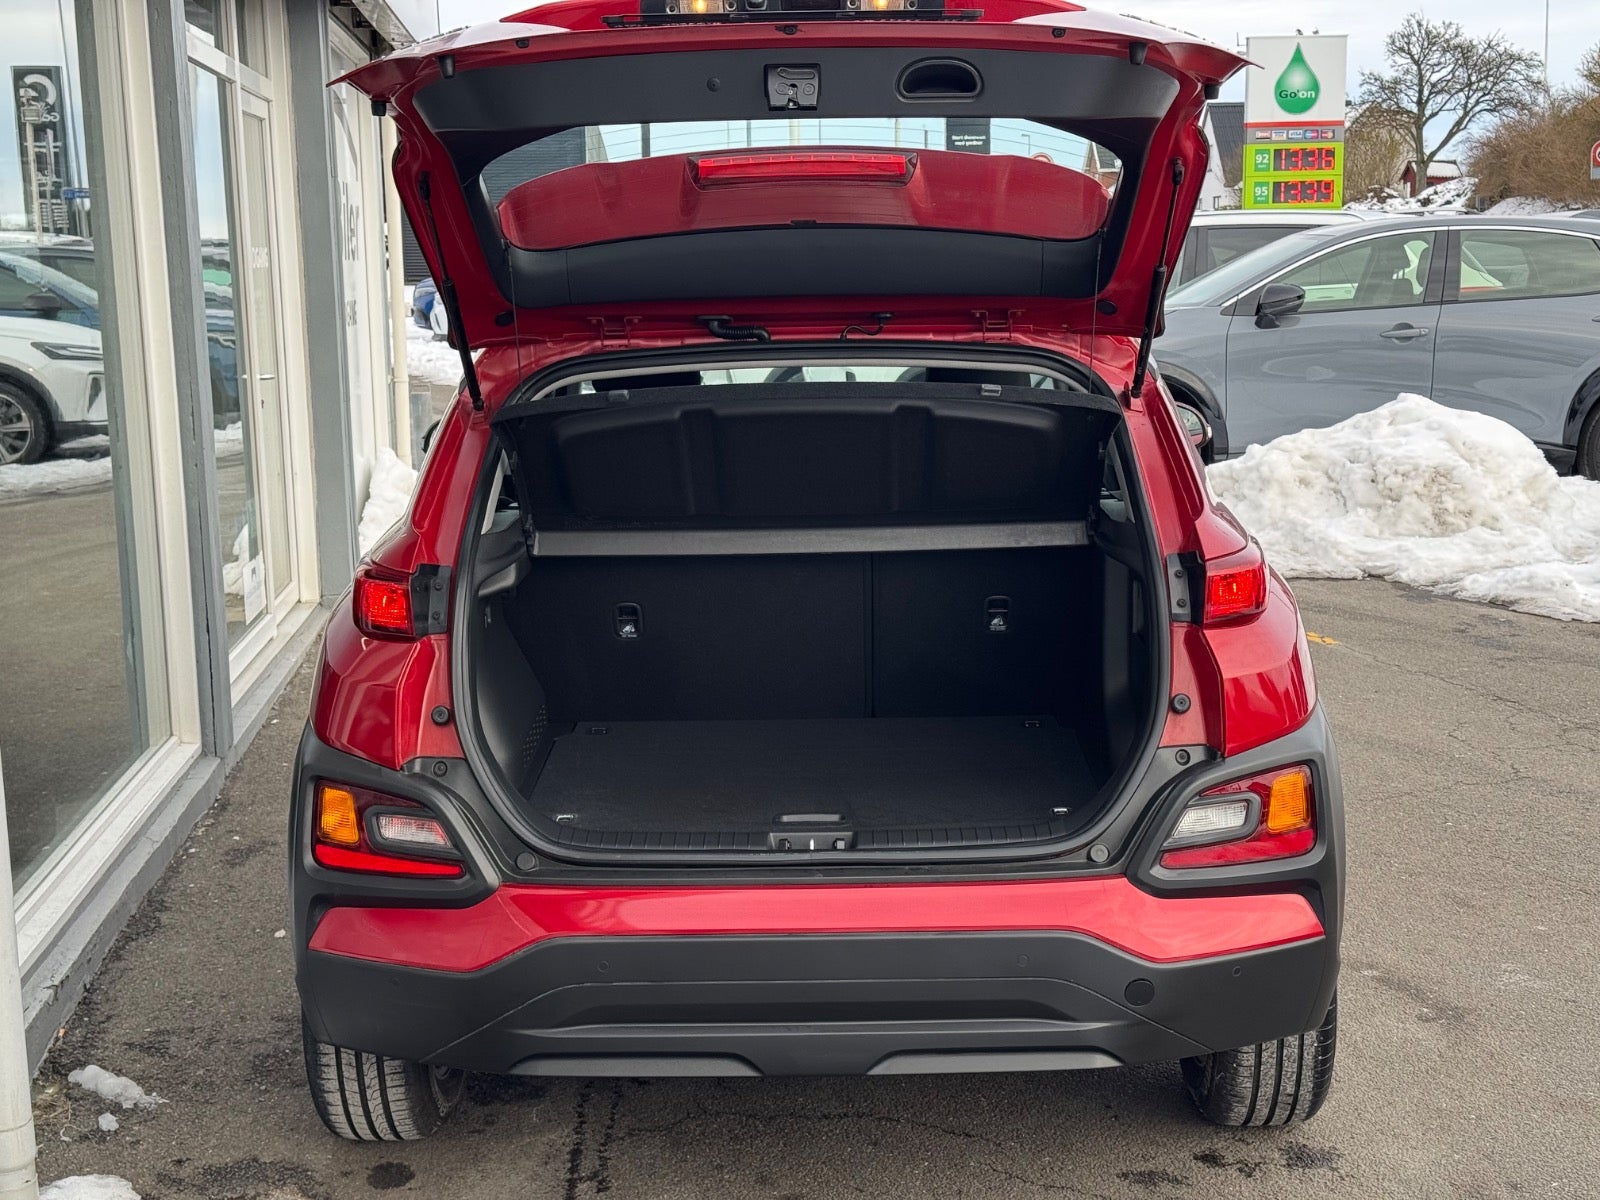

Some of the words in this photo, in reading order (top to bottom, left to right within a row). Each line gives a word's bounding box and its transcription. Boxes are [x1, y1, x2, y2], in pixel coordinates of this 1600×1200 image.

[1279, 89, 1315, 99] Go'on
[1256, 154, 1269, 164] 92
[1255, 186, 1268, 196] 95
